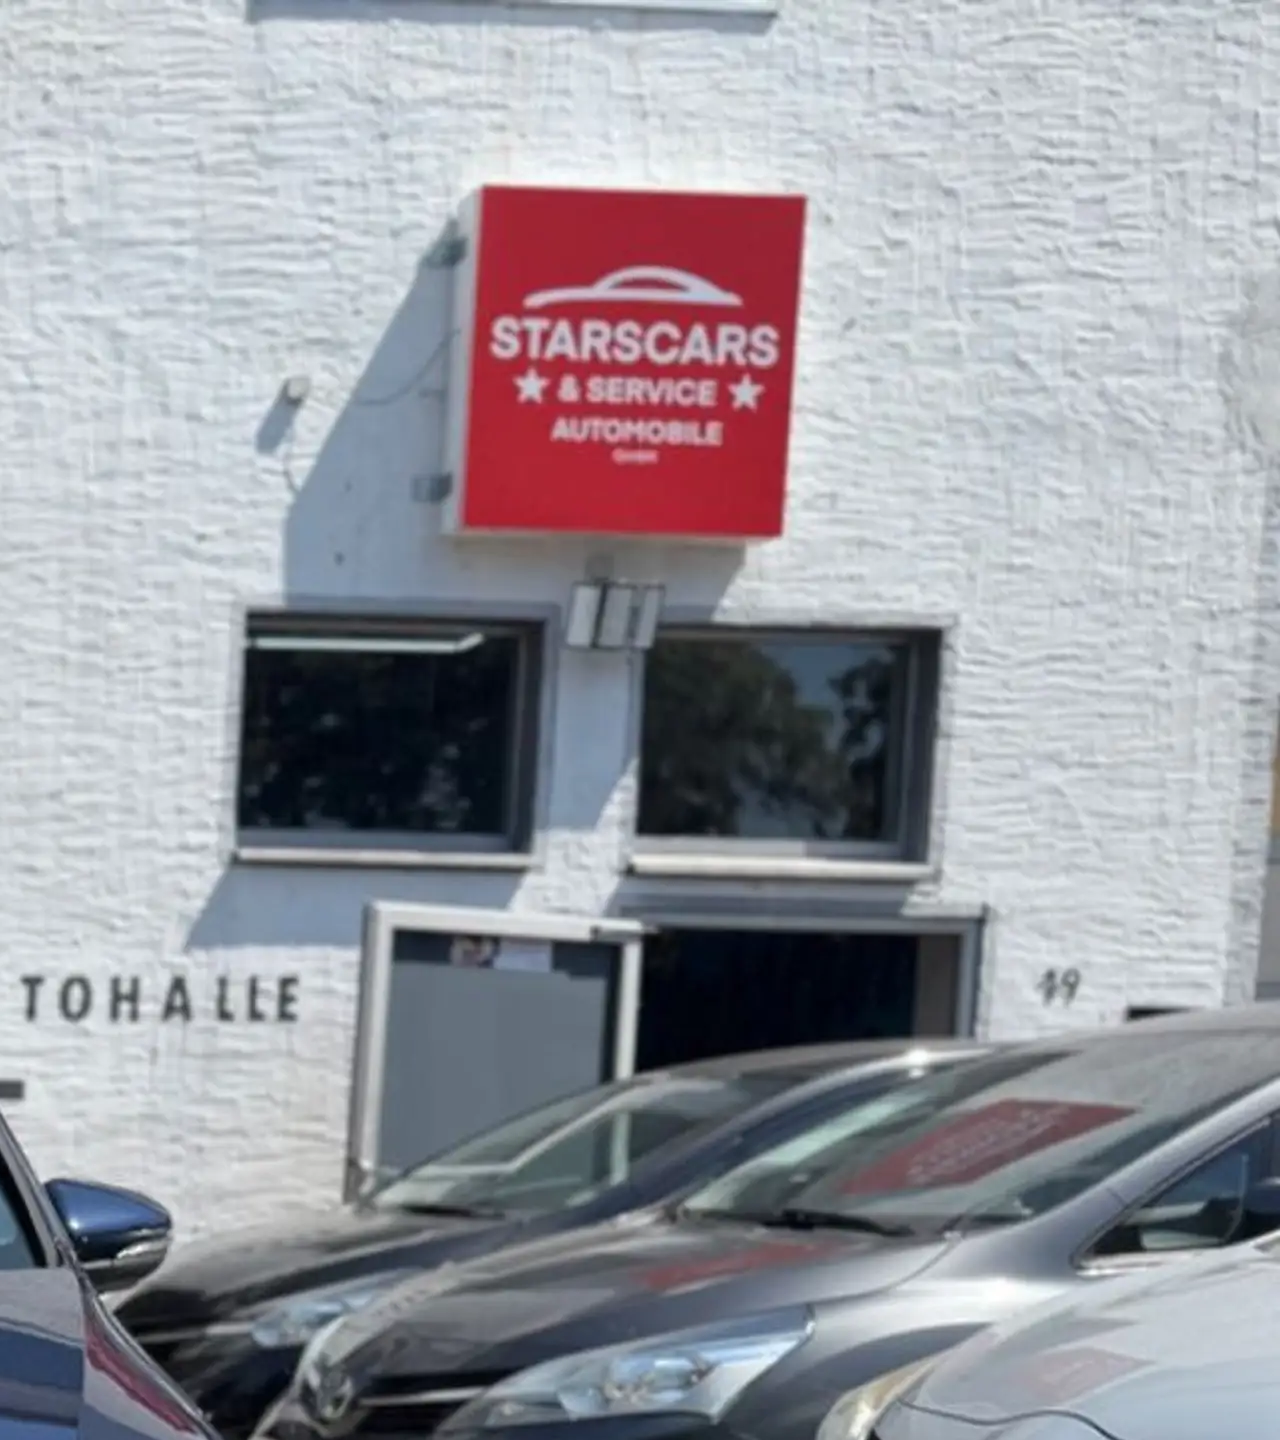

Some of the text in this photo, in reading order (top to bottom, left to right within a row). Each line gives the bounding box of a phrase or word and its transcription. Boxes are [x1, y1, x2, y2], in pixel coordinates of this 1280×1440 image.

[490, 314, 780, 368] STARSCARS
[557, 373, 718, 407] & SERVICE
[550, 416, 724, 447] AUTOMOBILE
